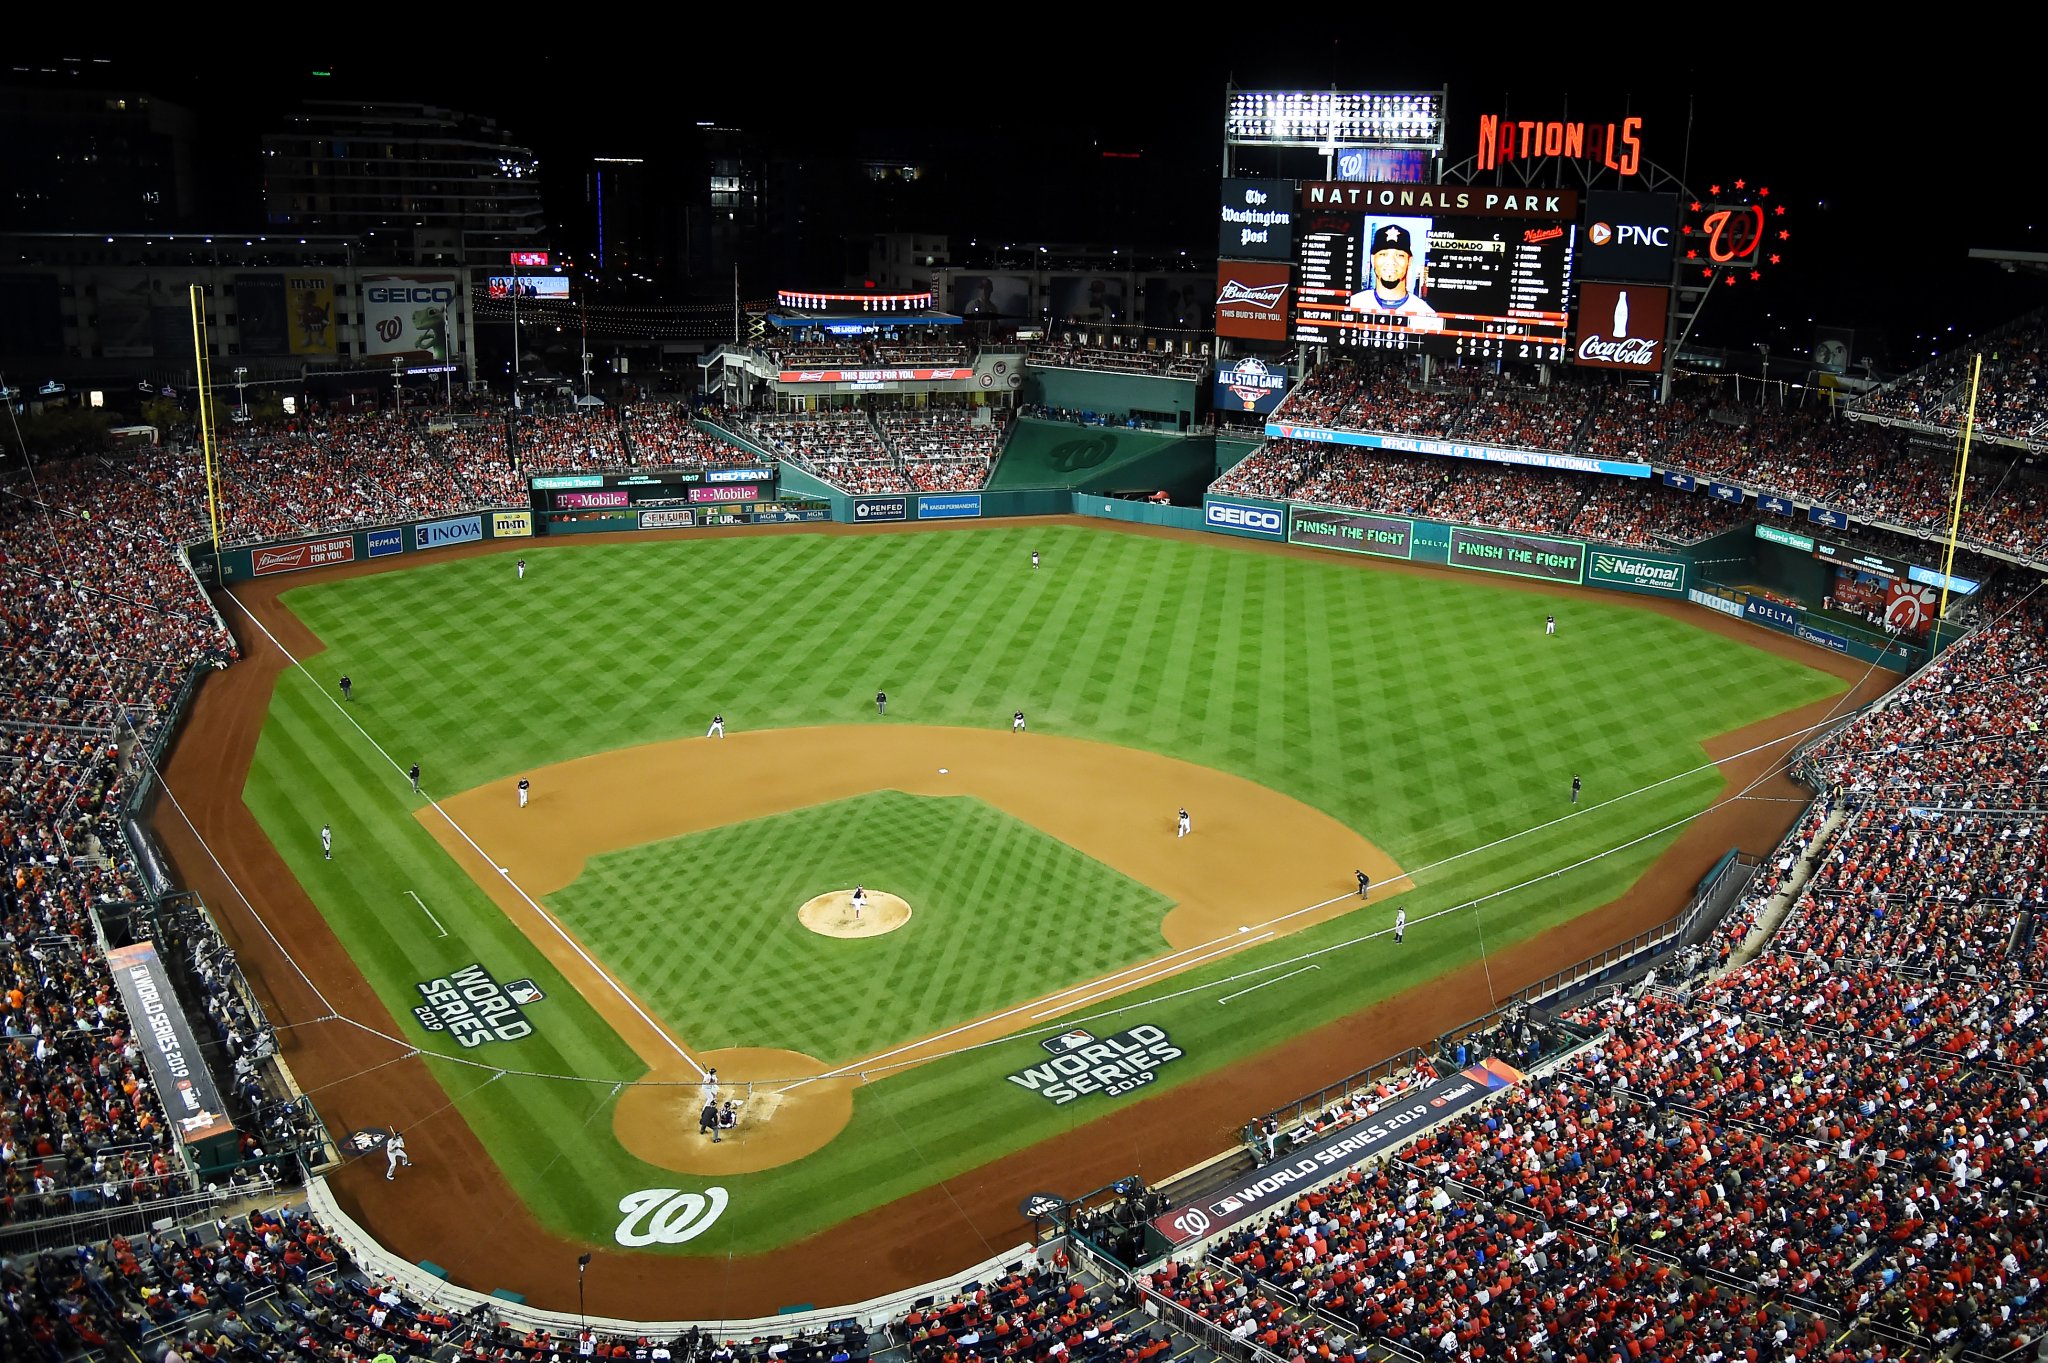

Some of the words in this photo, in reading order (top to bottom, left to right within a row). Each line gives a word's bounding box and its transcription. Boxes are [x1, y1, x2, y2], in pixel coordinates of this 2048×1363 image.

[1478, 115, 1642, 176] NATIONALS
[1245, 189, 1267, 205] The
[1311, 187, 1469, 209] NATIONALS
[1485, 194, 1560, 212] PARK
[1222, 205, 1290, 227] Washington
[1241, 229, 1268, 245] Post
[1523, 225, 1563, 243] Nationals
[1616, 225, 1669, 247] PNC
[1493, 243, 1501, 251] 12
[369, 288, 453, 303] GEICO
[1223, 284, 1280, 301] Budweiser
[1221, 310, 1235, 318] THIS
[1236, 311, 1254, 319] BUD'S
[1255, 312, 1267, 320] FOR
[1267, 313, 1281, 321] YOU.
[1520, 345, 1528, 358] 2
[1536, 346, 1543, 360] 1
[1549, 347, 1559, 360] 2
[1578, 335, 1658, 365] Coca-Cola
[840, 371, 859, 380] THIS
[859, 371, 881, 380] BUD'S
[882, 371, 898, 379] FOR
[898, 370, 915, 379] YOU.
[1236, 374, 1258, 387] STAR
[1260, 376, 1283, 389] GAME
[1304, 432, 1334, 440] DELTA
[1381, 438, 1418, 451] OFFICIAL
[1419, 441, 1453, 455] AIRLINE
[1454, 446, 1466, 455] OF
[1468, 448, 1484, 459] THE
[1486, 450, 1546, 466] WASHINGTON
[1549, 456, 1602, 472] NATIONALS.
[545, 480, 572, 488] Harris
[741, 470, 768, 480] FAN
[871, 504, 902, 512] PENFED
[1208, 506, 1280, 529] GEICO
[433, 523, 480, 541] INOVA
[1296, 520, 1337, 536] FINISH
[1341, 525, 1363, 540] THE
[1367, 529, 1405, 545] FIGHT
[1765, 530, 1788, 544] Harris
[1789, 536, 1812, 549] Teeter
[310, 544, 327, 553] THIS
[328, 541, 351, 551] BUD'S
[369, 536, 401, 548] RE/MAX
[1422, 540, 1448, 548] DELTA
[1819, 545, 1835, 555] 10:17
[262, 553, 301, 566] Budweiser
[310, 553, 326, 563] FOR
[327, 551, 345, 561] YOU.
[1458, 542, 1502, 559] FINISH
[1507, 549, 1531, 563] THE
[1536, 553, 1576, 569] FIGHT
[1614, 560, 1678, 581] National
[1649, 579, 1673, 588] Rental
[1759, 607, 1794, 625] DELTA
[1805, 632, 1825, 645] Choose
[135, 976, 164, 1014] WORLD
[451, 965, 532, 1040] WORLD
[415, 1006, 443, 1030] 2019
[419, 979, 494, 1047] SERIES
[149, 1012, 180, 1053] SERIES
[166, 1051, 190, 1077] 2019
[1008, 1025, 1165, 1089] WORLD
[1043, 1042, 1182, 1104] SERIES
[1105, 1072, 1153, 1096] 2019
[1237, 1159, 1318, 1201] WORLD
[1317, 1126, 1388, 1165] SERIES
[1384, 1104, 1428, 1129] 2019
